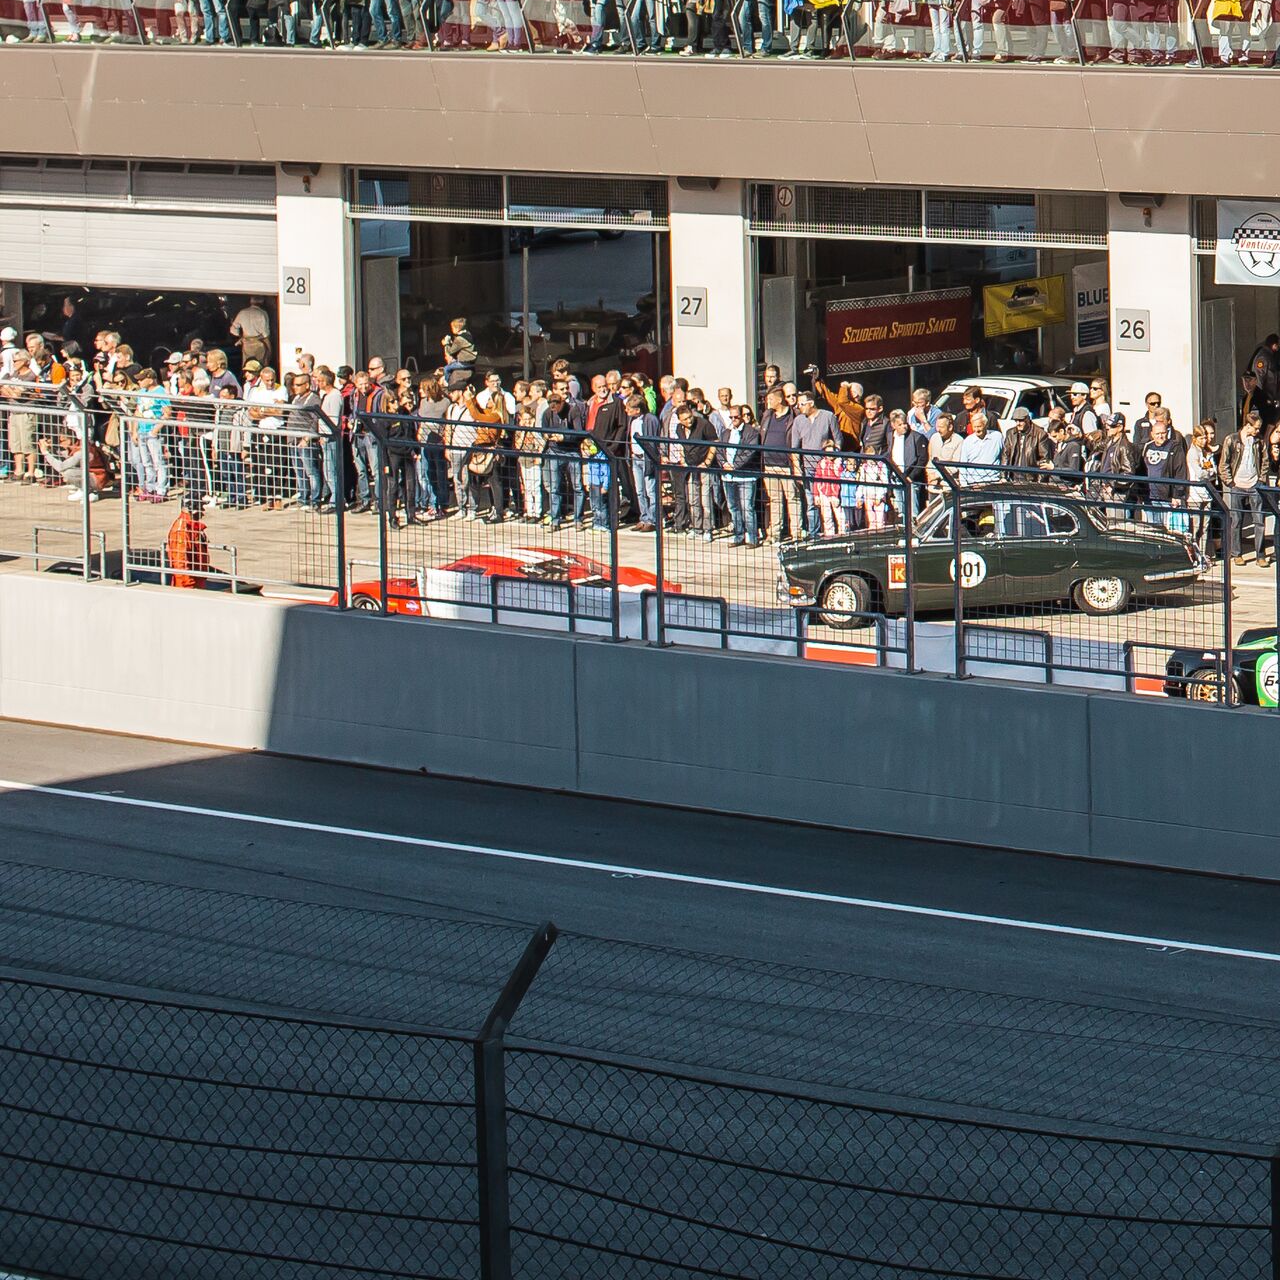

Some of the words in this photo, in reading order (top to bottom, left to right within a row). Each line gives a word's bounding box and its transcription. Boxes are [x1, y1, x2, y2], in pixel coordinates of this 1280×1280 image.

[286, 276, 306, 294] 28
[680, 296, 703, 316] 27
[841, 326, 888, 345] SCUDERIA
[889, 321, 926, 339] SPIRITO
[926, 317, 957, 335] SANTO
[1119, 319, 1145, 340] 26
[954, 562, 981, 578] 01
